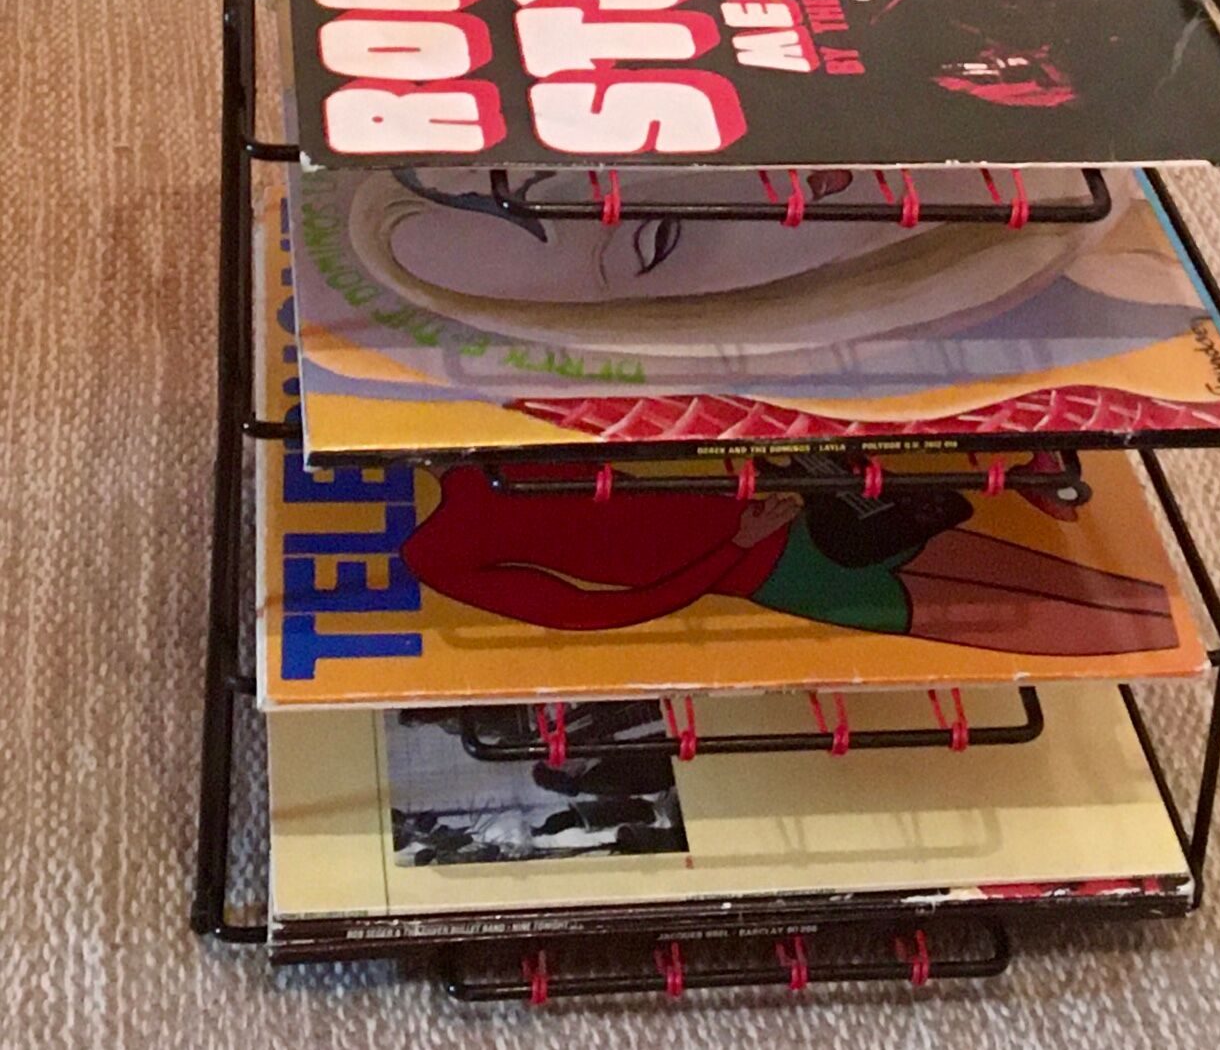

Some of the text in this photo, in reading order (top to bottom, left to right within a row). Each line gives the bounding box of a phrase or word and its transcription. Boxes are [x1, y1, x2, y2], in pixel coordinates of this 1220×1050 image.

[820, 47, 865, 75] BY
[727, 445, 747, 455] AND
[750, 445, 767, 454] THE
[818, 443, 846, 452] LAYLA
